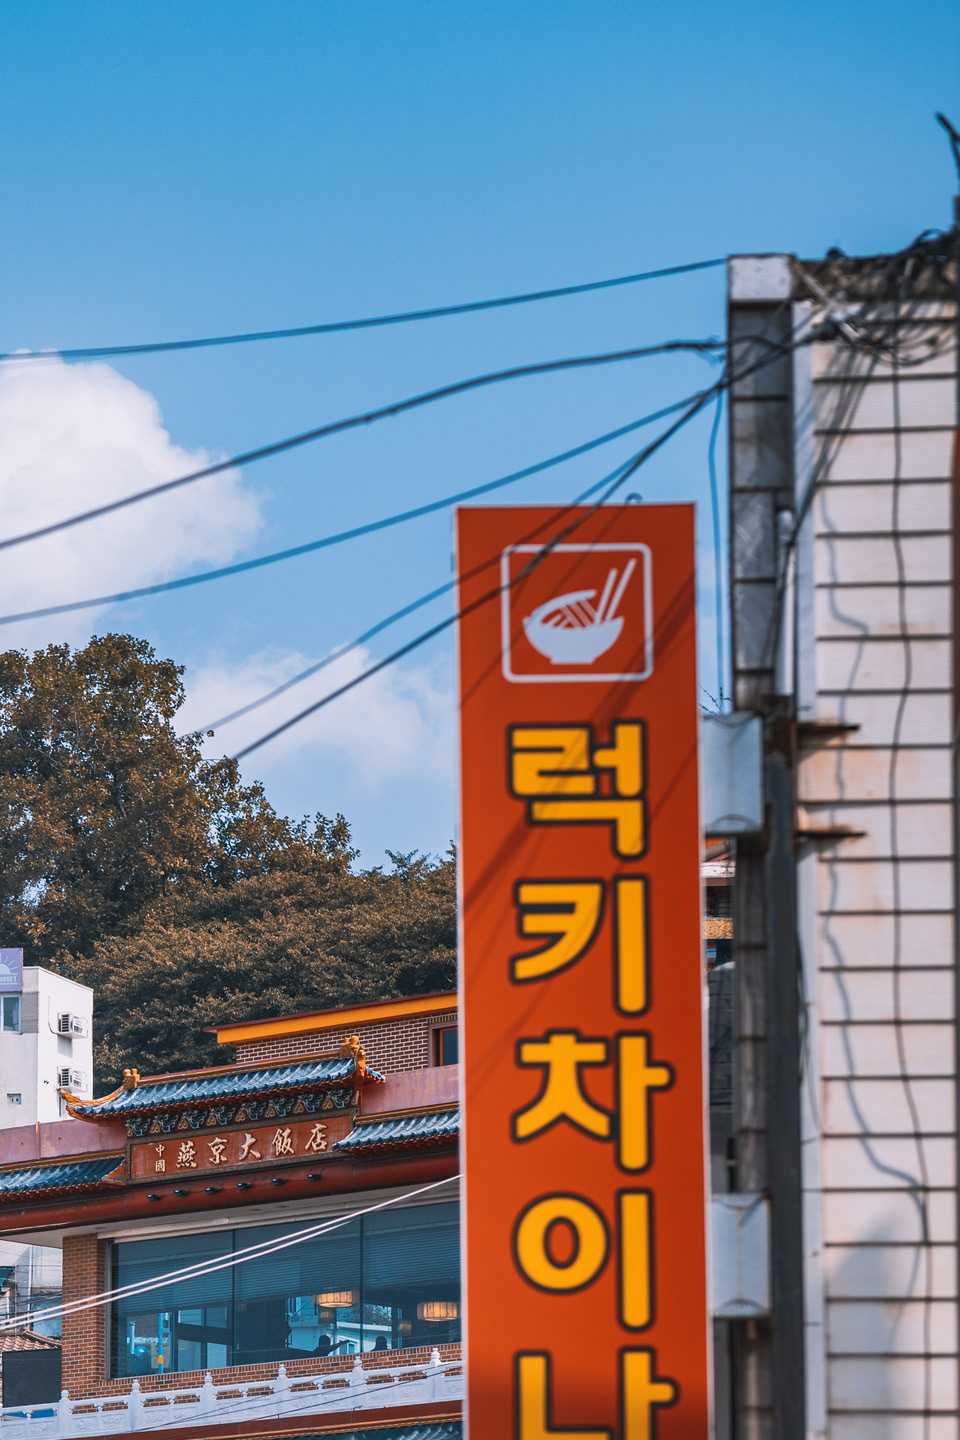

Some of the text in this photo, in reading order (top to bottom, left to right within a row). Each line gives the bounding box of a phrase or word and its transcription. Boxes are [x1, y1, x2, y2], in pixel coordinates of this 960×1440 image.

[175, 1123, 328, 1169] 燕京大飯店
